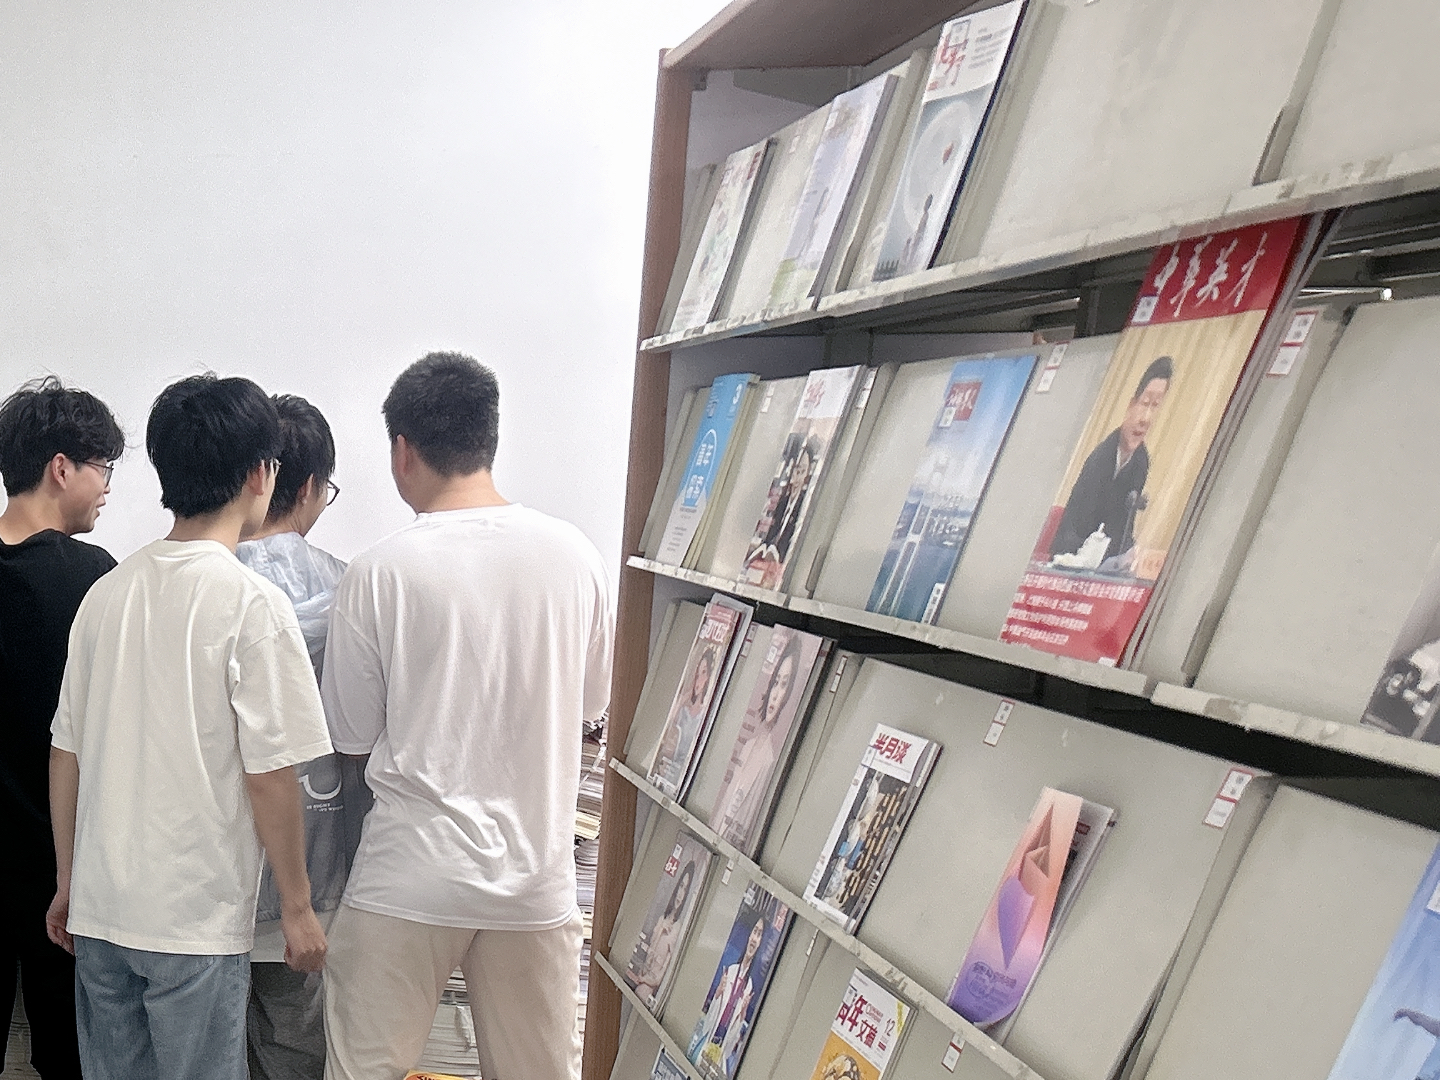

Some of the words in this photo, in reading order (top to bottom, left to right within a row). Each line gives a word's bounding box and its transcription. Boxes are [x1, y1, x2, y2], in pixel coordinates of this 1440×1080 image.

[1153, 232, 1267, 317] 中华英才
[874, 732, 912, 764] 半月谈
[884, 1018, 896, 1037] 12
